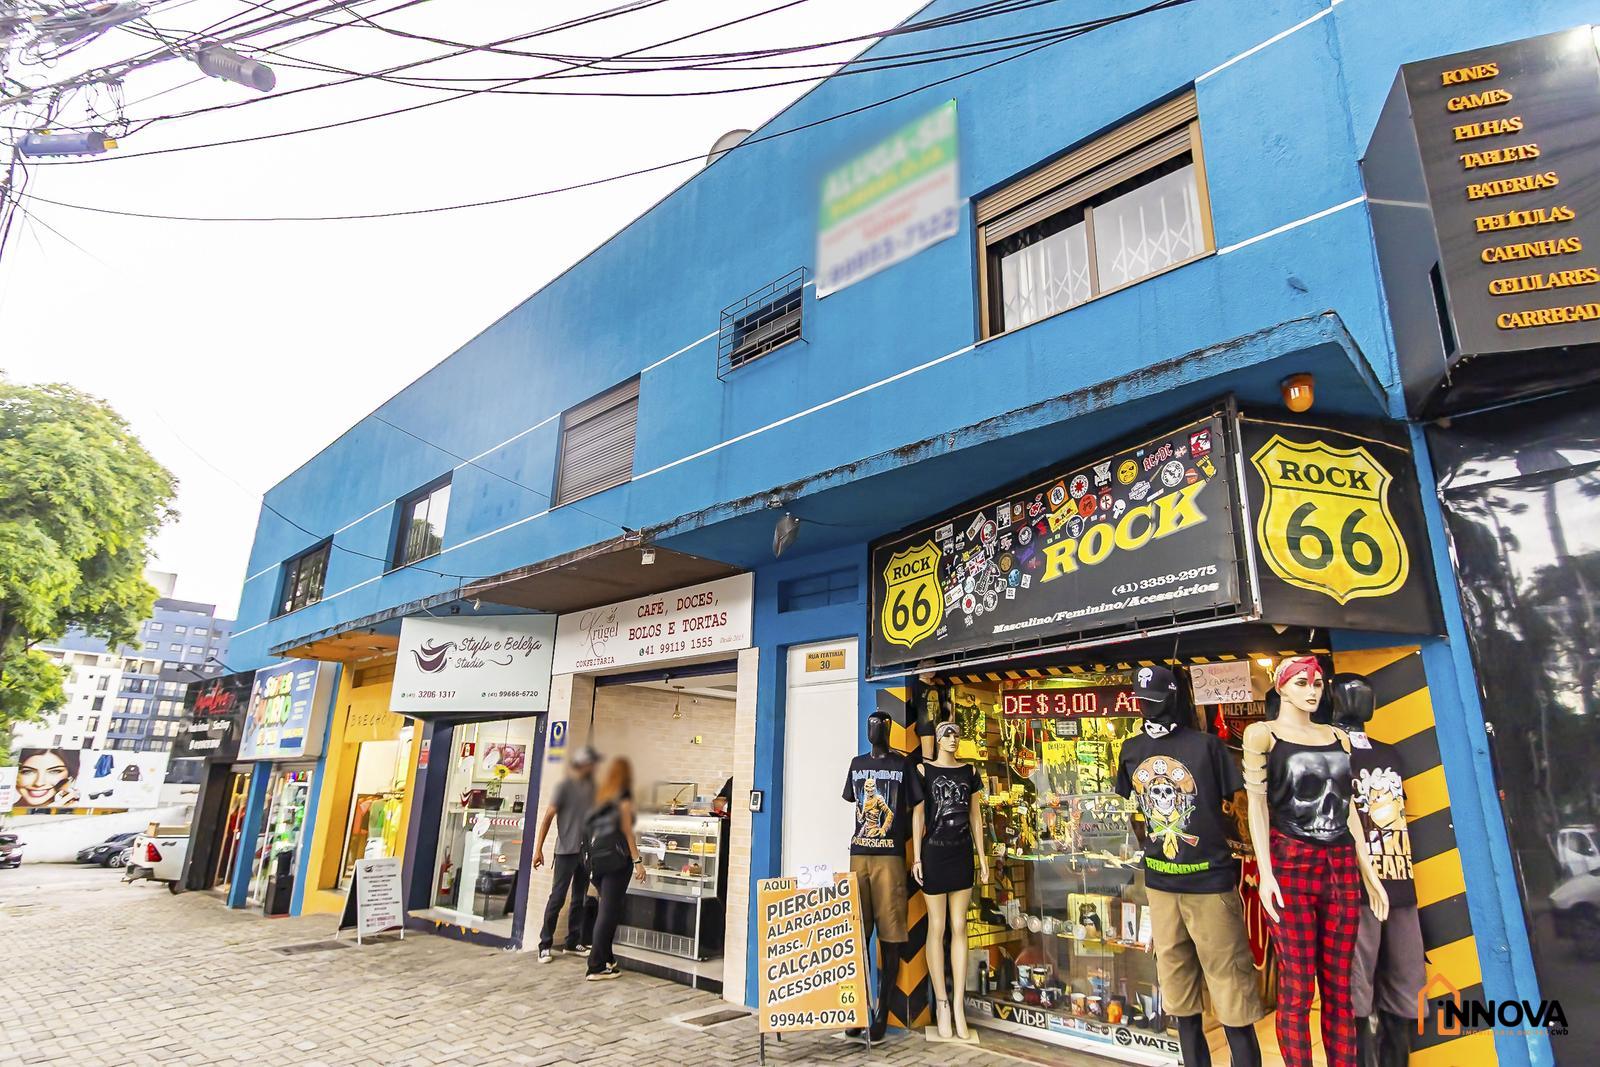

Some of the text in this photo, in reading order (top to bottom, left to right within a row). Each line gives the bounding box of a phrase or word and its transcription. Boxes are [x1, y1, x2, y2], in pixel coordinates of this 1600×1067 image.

[1447, 88, 1513, 112] GAMES
[1453, 116, 1524, 141] PILHAS
[1460, 143, 1541, 169] TABLETS
[1467, 171, 1559, 200] BATERIAS
[1475, 205, 1576, 232] PELÍCULAS
[1481, 236, 1582, 263] CAPINHAS
[1488, 267, 1600, 296] CELULARES
[1277, 460, 1371, 492] ROCK
[1041, 480, 1208, 582] ROCK
[1286, 501, 1383, 576] 66
[893, 556, 931, 580] ROCK
[1111, 565, 1217, 597] (41) 3359-2975
[637, 591, 719, 618] CAFÉ, DOCES,
[892, 583, 931, 631] 66
[629, 612, 727, 640] BOLOS E TORTAS
[494, 641, 502, 650] e
[503, 635, 542, 657] Beleza
[645, 636, 713, 655] 41 99119 1555
[454, 657, 486, 669] Studio
[576, 656, 615, 668] CONFEITARIA
[820, 660, 831, 670] 30
[418, 690, 436, 699] 3206
[439, 690, 456, 699] 1317
[499, 690, 539, 698] 99666-6720
[1004, 695, 1032, 715] DE
[1054, 692, 1097, 717] 3,00
[764, 880, 790, 891] AQUI
[767, 879, 850, 921] PIERCING
[767, 900, 851, 939] ALARGADOR
[767, 942, 803, 958] Masc.
[817, 920, 852, 942] Femi.
[767, 939, 854, 981] CALÇADOS
[767, 962, 856, 1004] ACESSÓRIOS
[841, 992, 855, 1004] 66
[770, 1009, 856, 1027] 99944-0704
[1133, 1034, 1180, 1053] WATS
